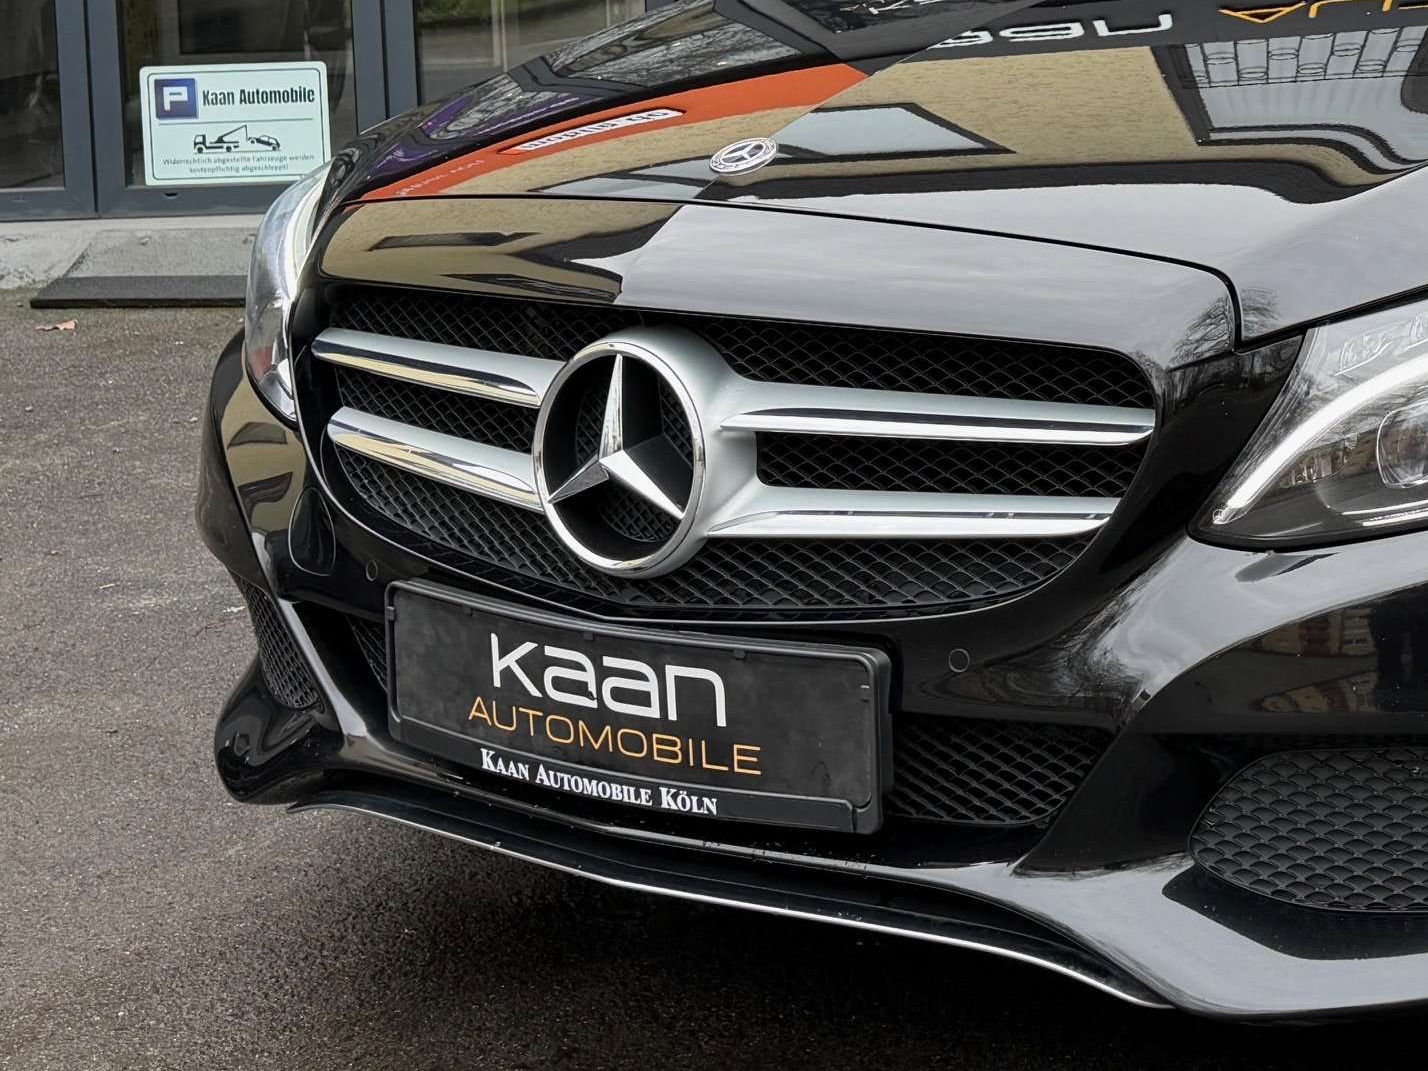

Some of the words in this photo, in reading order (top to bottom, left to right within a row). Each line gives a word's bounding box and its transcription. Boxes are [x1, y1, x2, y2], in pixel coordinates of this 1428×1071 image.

[202, 90, 235, 106] Kaan
[239, 87, 315, 105] Automobile
[467, 696, 764, 776] AUTOMOBILE
